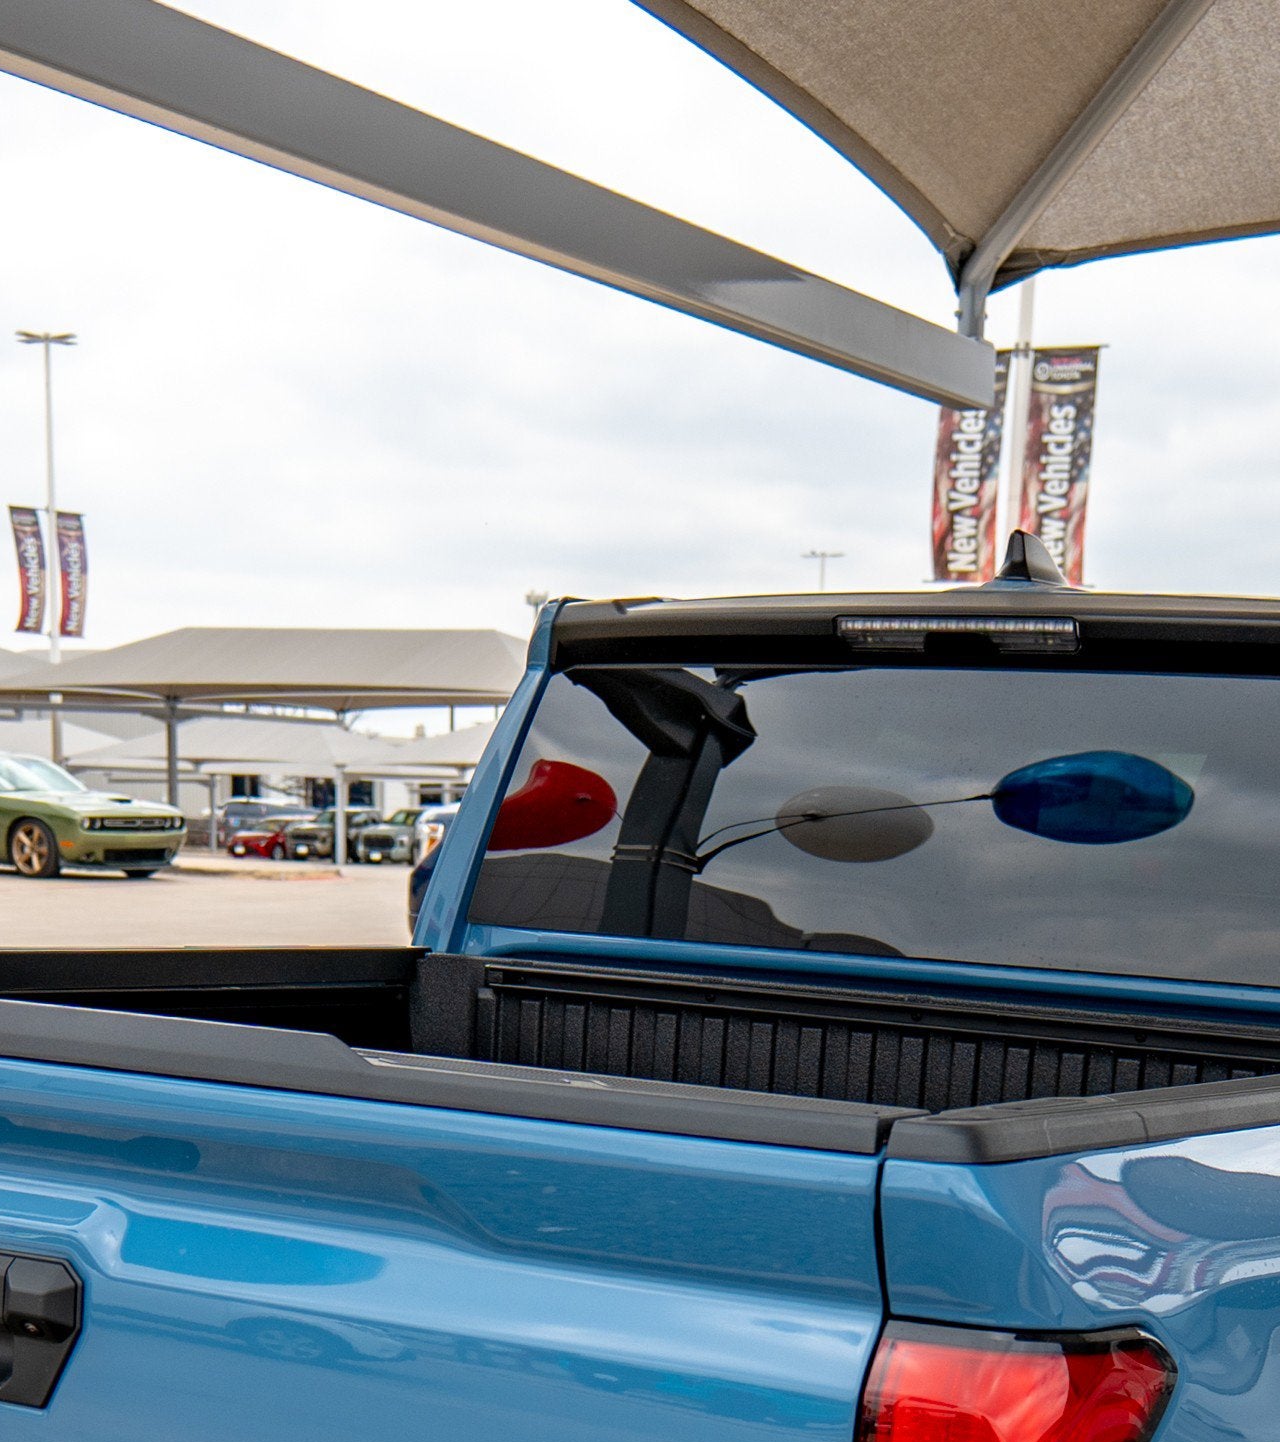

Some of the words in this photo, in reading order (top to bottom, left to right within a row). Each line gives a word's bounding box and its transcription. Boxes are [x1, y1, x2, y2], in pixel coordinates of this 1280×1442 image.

[947, 409, 986, 512] Vehicles
[1036, 404, 1077, 514] Vehicles
[23, 536, 40, 595] Vehicles
[66, 541, 81, 599] Vehicles
[947, 513, 979, 573] New
[1041, 517, 1067, 574] ew
[23, 597, 39, 628] New
[64, 600, 80, 631] New
